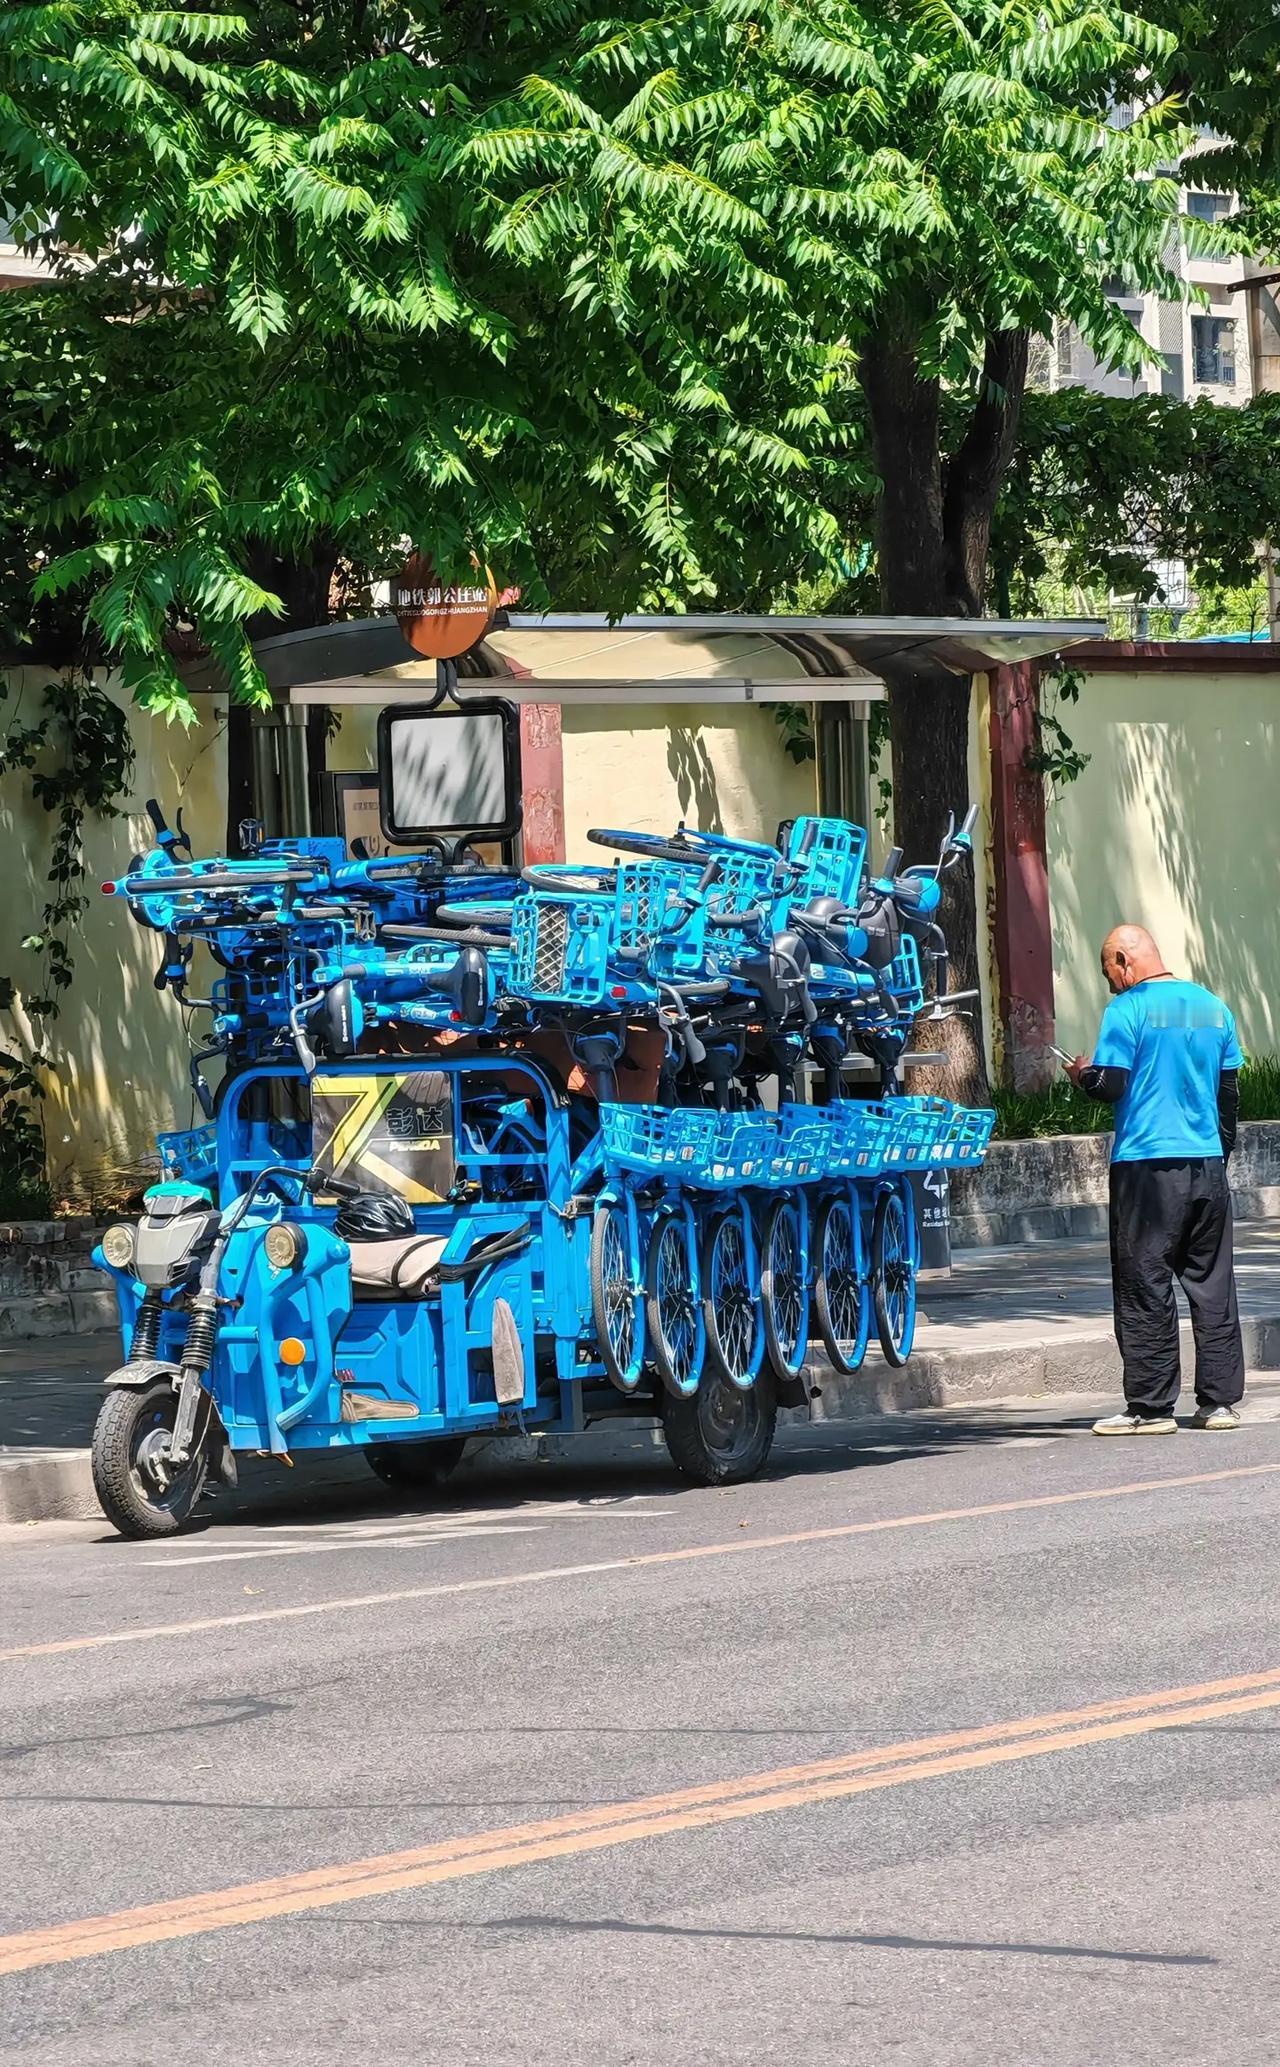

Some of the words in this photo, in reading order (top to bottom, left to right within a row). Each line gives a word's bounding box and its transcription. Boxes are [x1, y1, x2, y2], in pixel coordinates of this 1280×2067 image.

[398, 586, 487, 606] 地铁郭公庄站
[386, 1106, 444, 1137] 彭达
